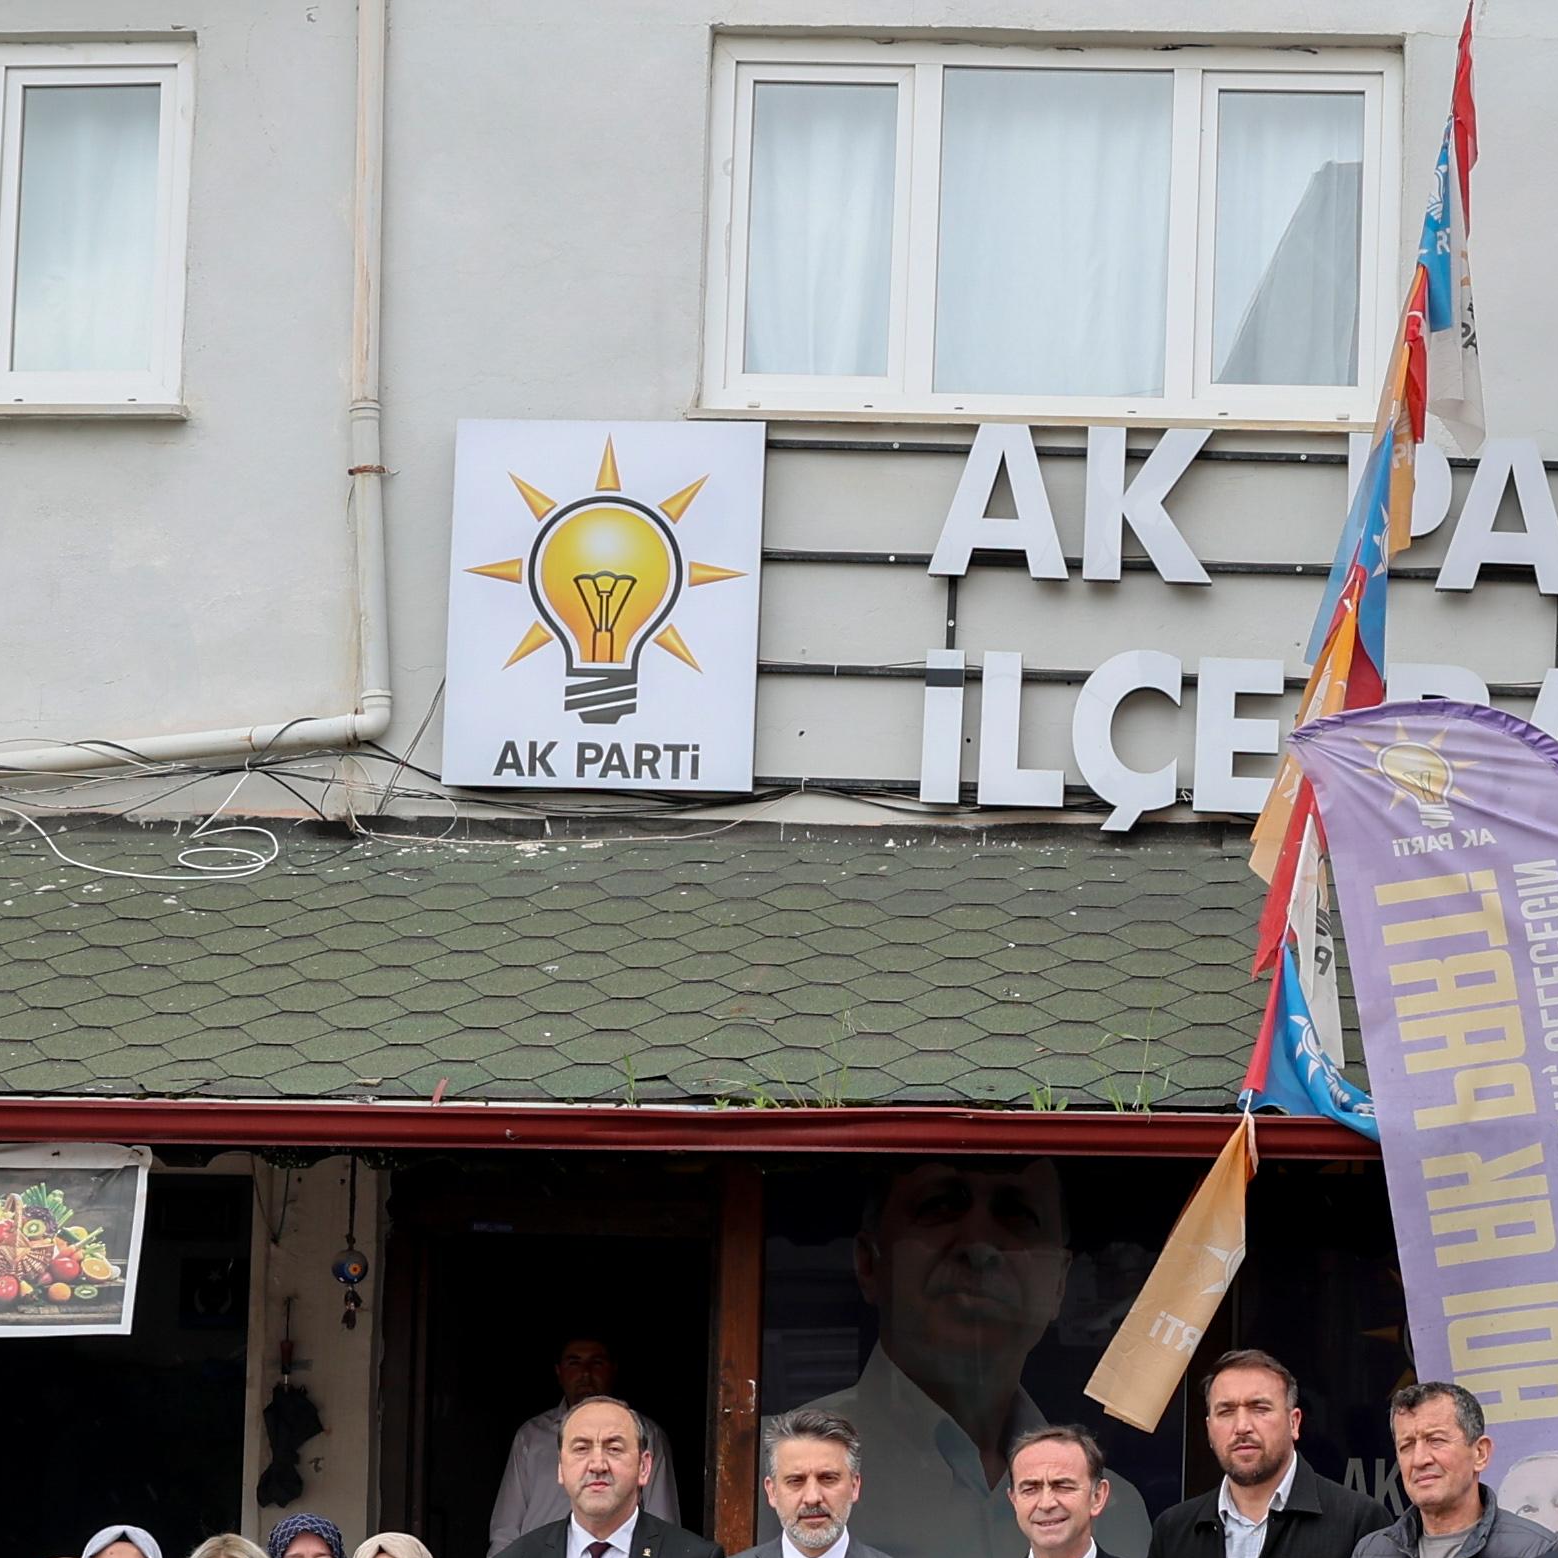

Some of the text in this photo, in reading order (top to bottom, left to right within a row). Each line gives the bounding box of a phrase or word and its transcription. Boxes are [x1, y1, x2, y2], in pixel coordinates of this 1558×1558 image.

[928, 421, 1213, 585] AK
[493, 741, 559, 777] AK
[919, 648, 1284, 832] İLÇE
[1344, 1457, 1405, 1516] AK
